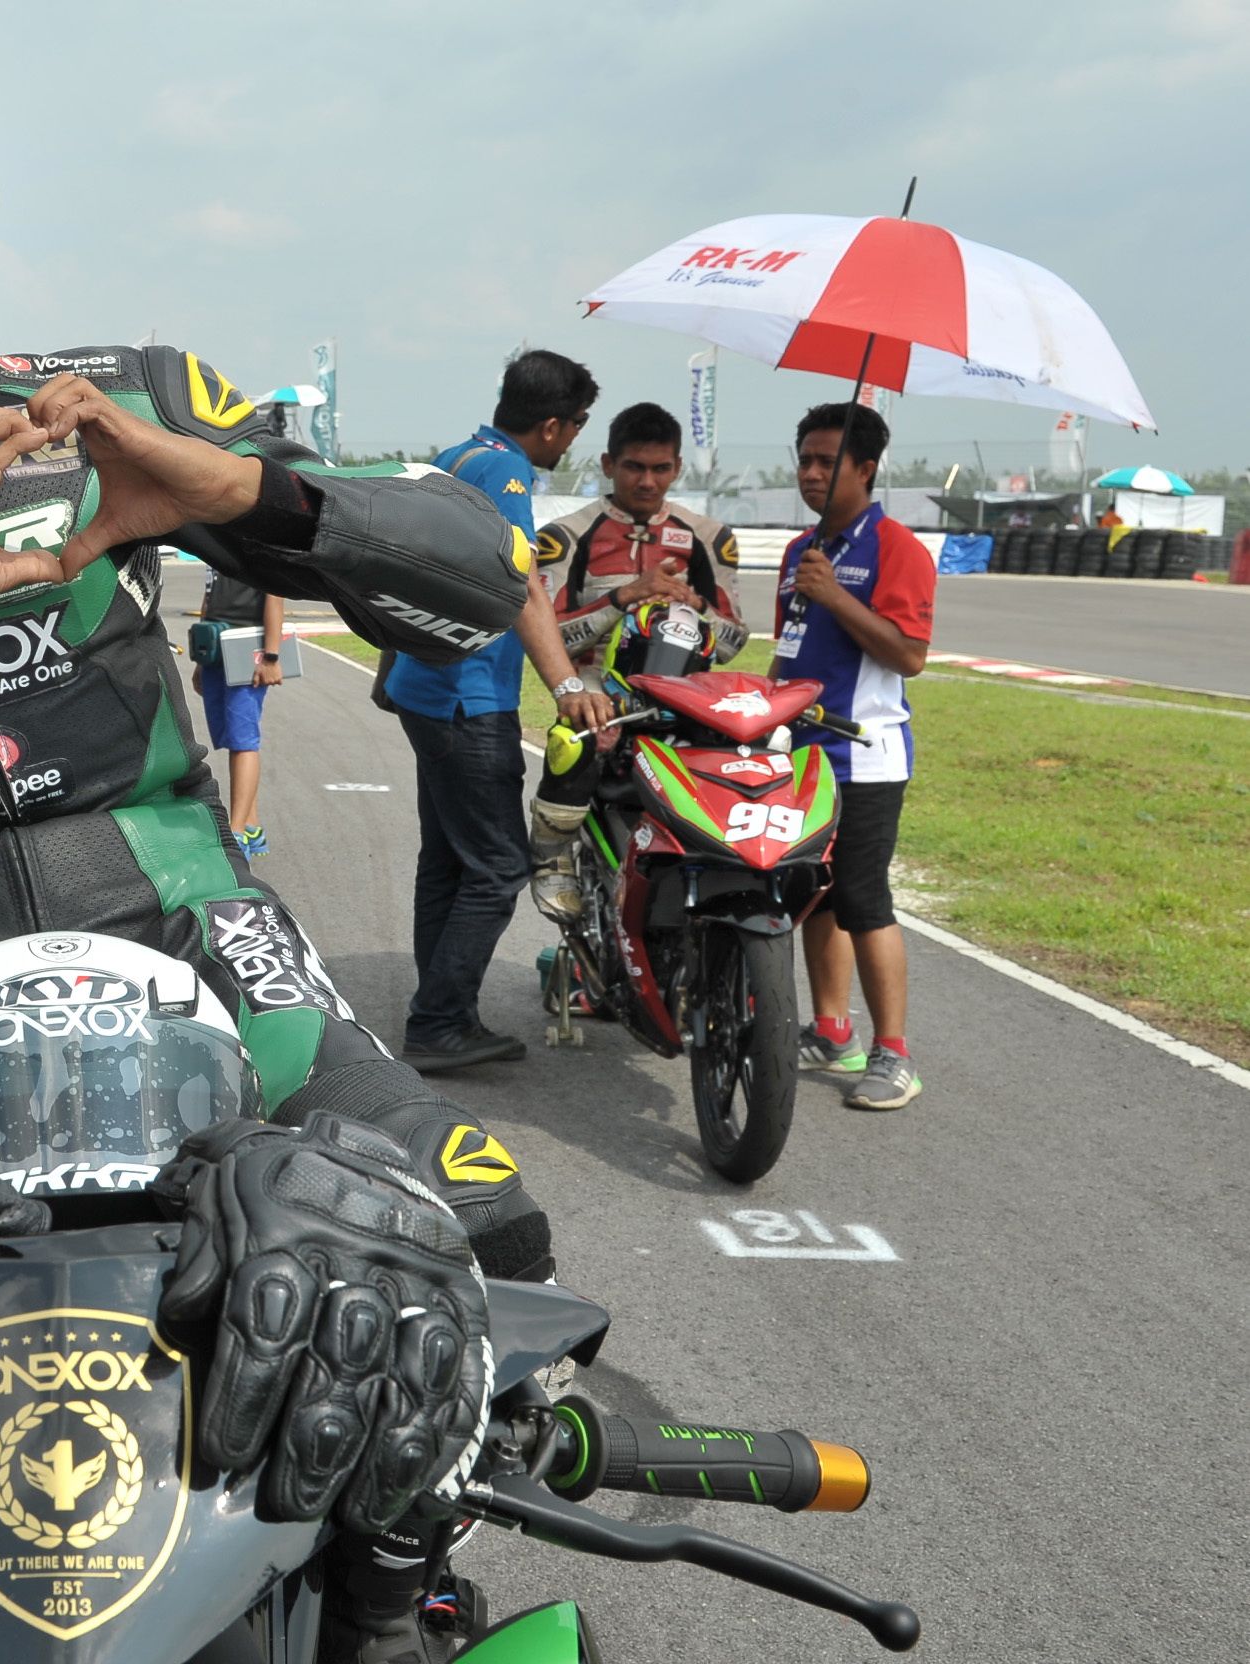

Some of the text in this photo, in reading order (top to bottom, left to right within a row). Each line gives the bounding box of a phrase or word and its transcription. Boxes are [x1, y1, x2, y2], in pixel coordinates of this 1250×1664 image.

[681, 245, 802, 273] RK-M
[33, 355, 117, 372] Voopee
[669, 622, 699, 639] Arai
[0, 673, 31, 695] Are
[34, 659, 74, 683] One
[724, 801, 805, 843] 99
[261, 905, 279, 934] One
[3, 975, 128, 1007] KYT
[17, 1556, 60, 1571] THERE
[63, 1555, 84, 1570] WE
[87, 1555, 114, 1570] ARE
[117, 1556, 145, 1571] ONE
[52, 1580, 84, 1595] EST
[42, 1598, 93, 1617] 2013
